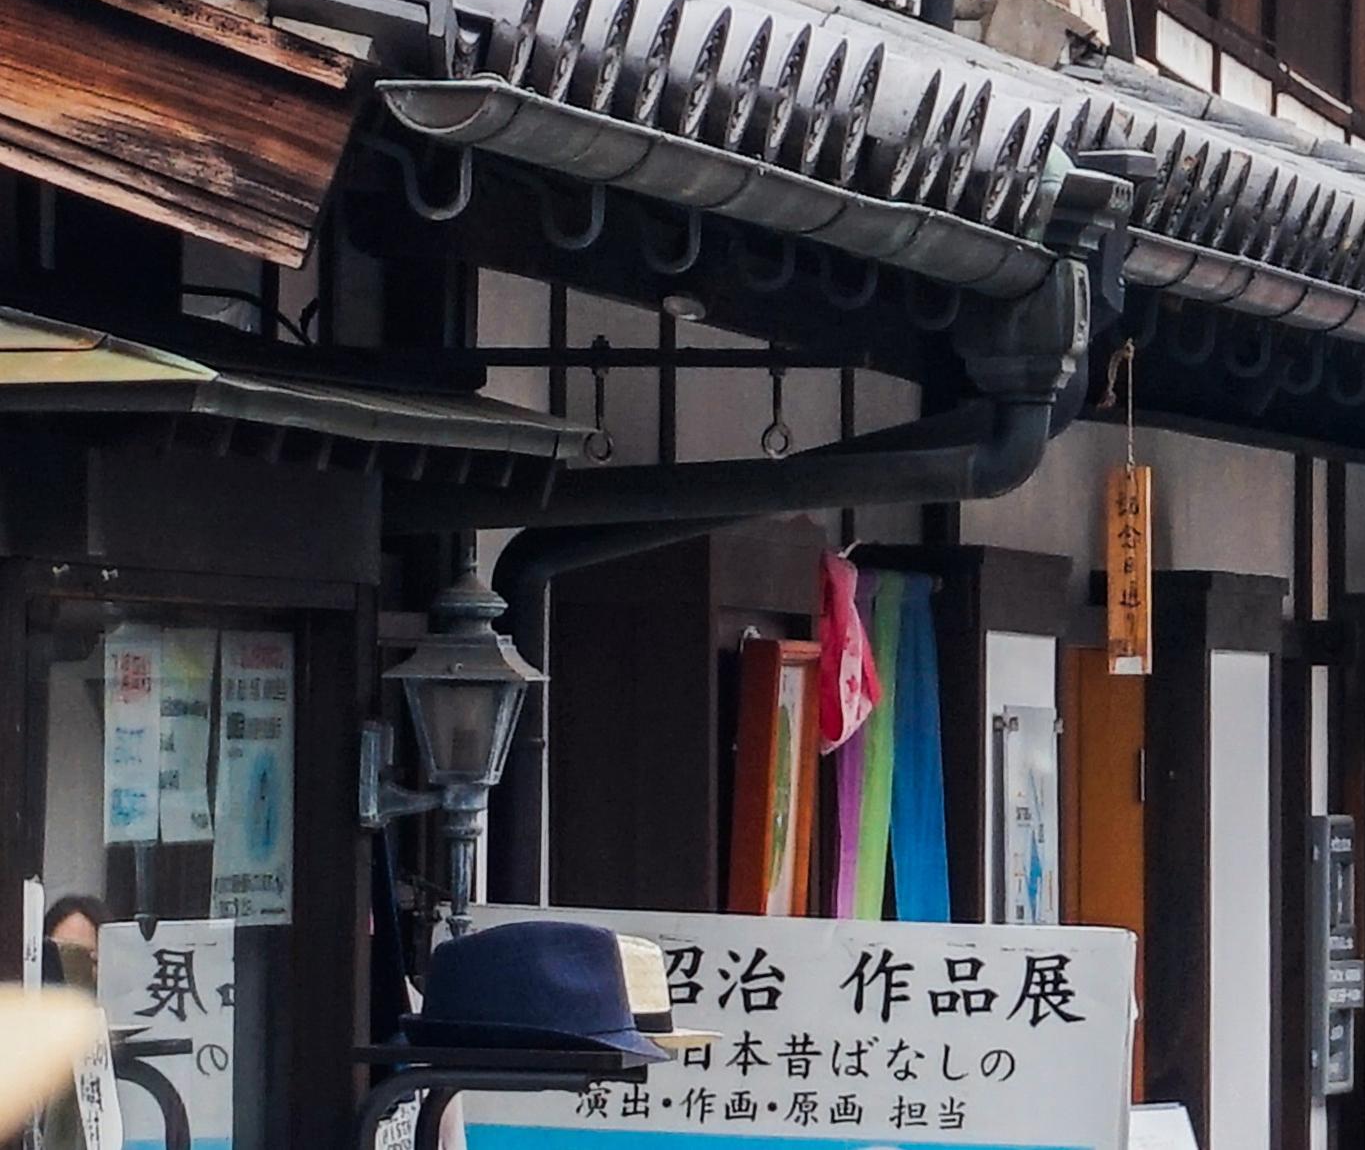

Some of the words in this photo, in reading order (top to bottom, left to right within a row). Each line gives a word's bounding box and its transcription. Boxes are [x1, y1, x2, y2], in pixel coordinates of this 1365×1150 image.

[838, 948, 1087, 1028] 作品展
[683, 1030, 1015, 1082] 日本昔ばなしの
[888, 1095, 966, 1130] 担当
